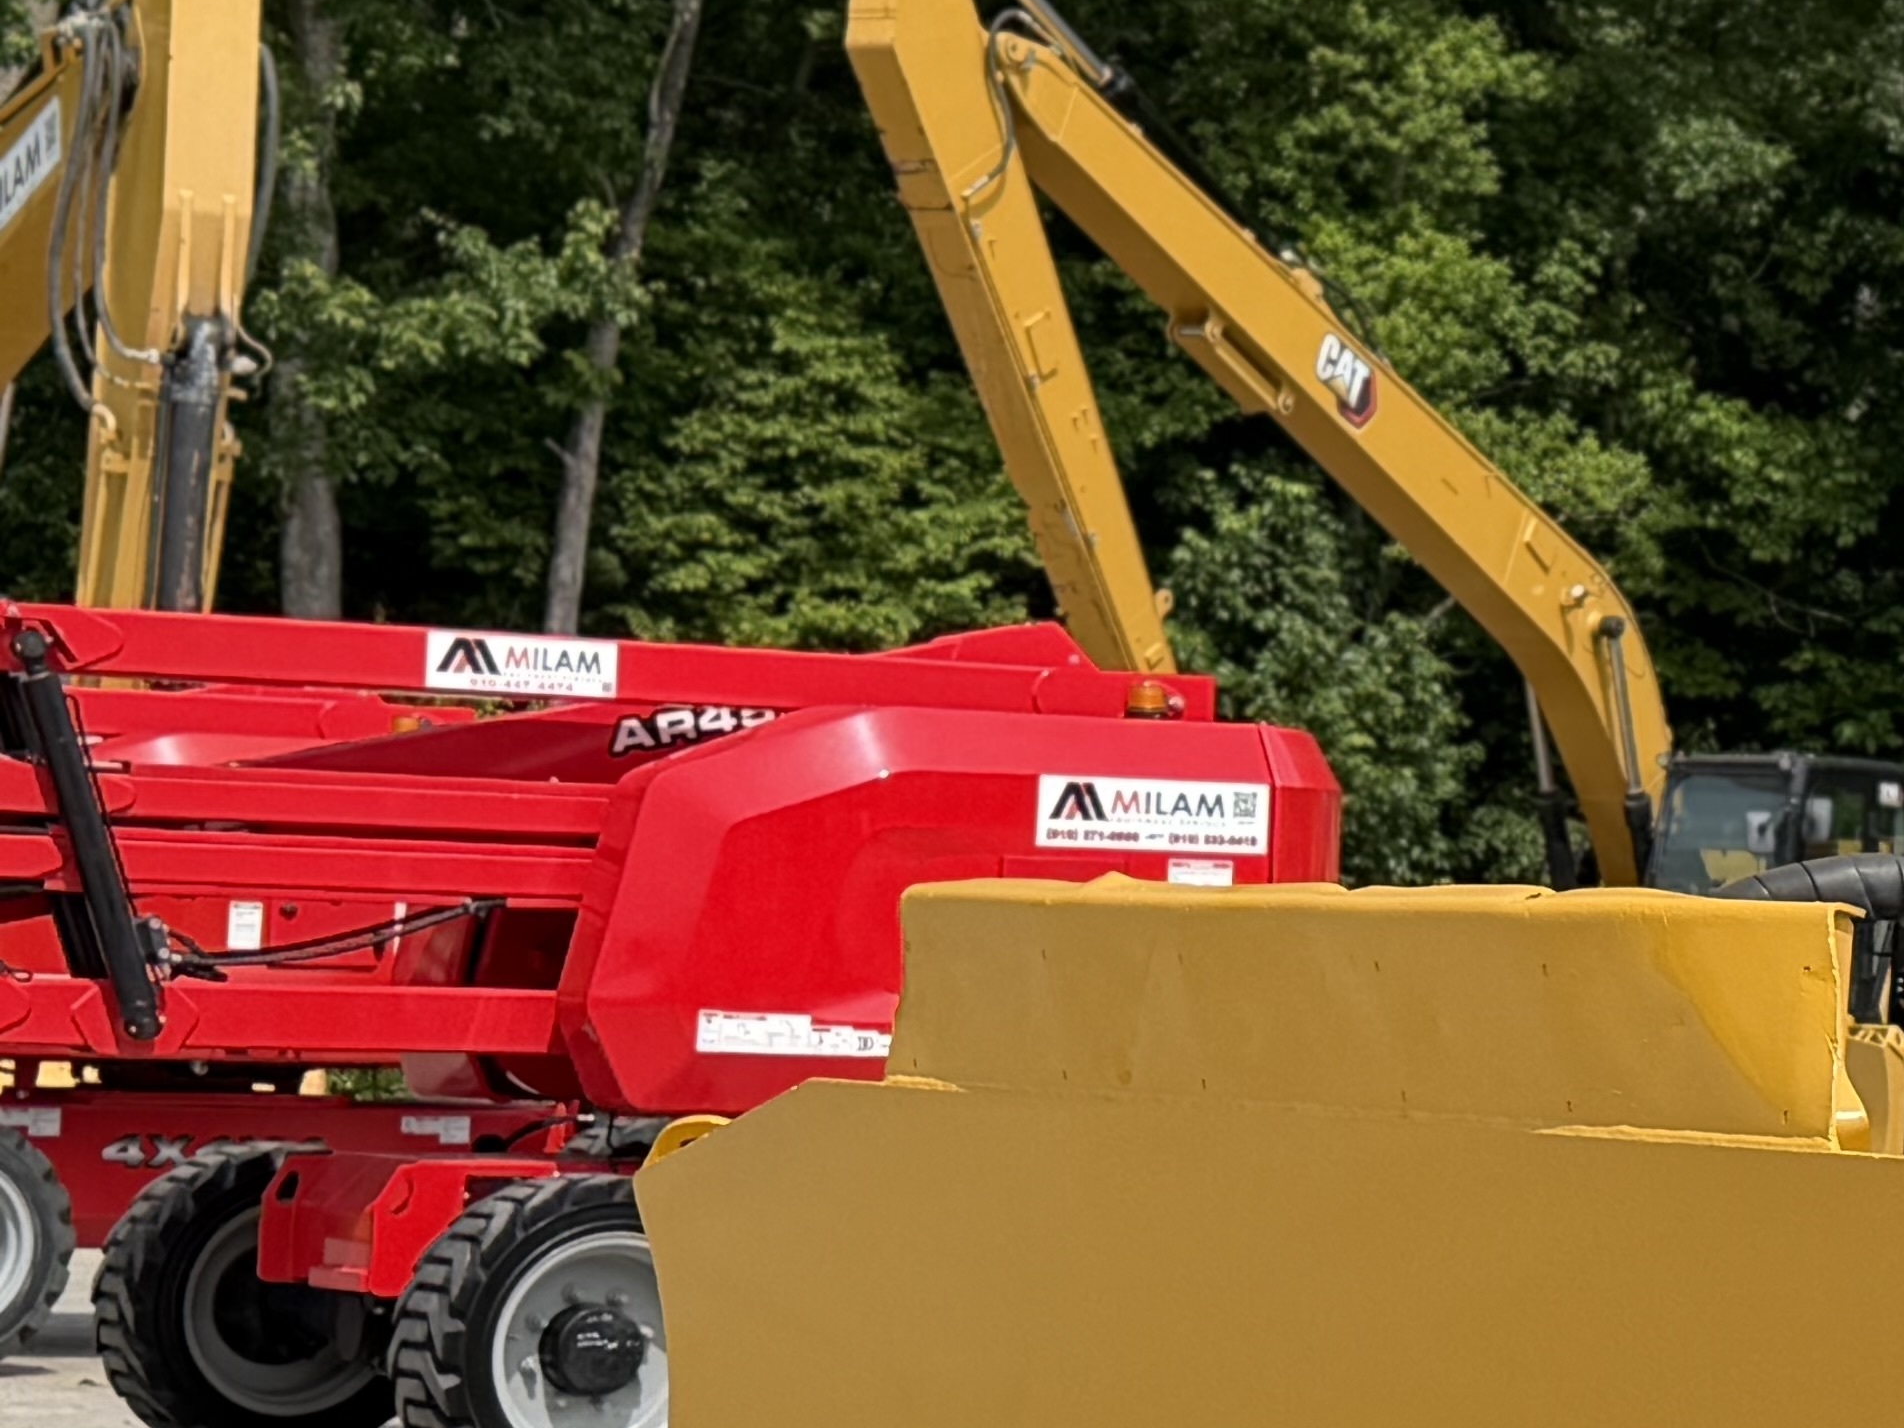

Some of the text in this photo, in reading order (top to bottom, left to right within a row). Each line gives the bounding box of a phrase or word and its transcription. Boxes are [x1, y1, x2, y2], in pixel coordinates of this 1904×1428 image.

[1316, 333, 1370, 408] CAT
[505, 646, 601, 674] MILAM
[1111, 790, 1225, 818] MILAM
